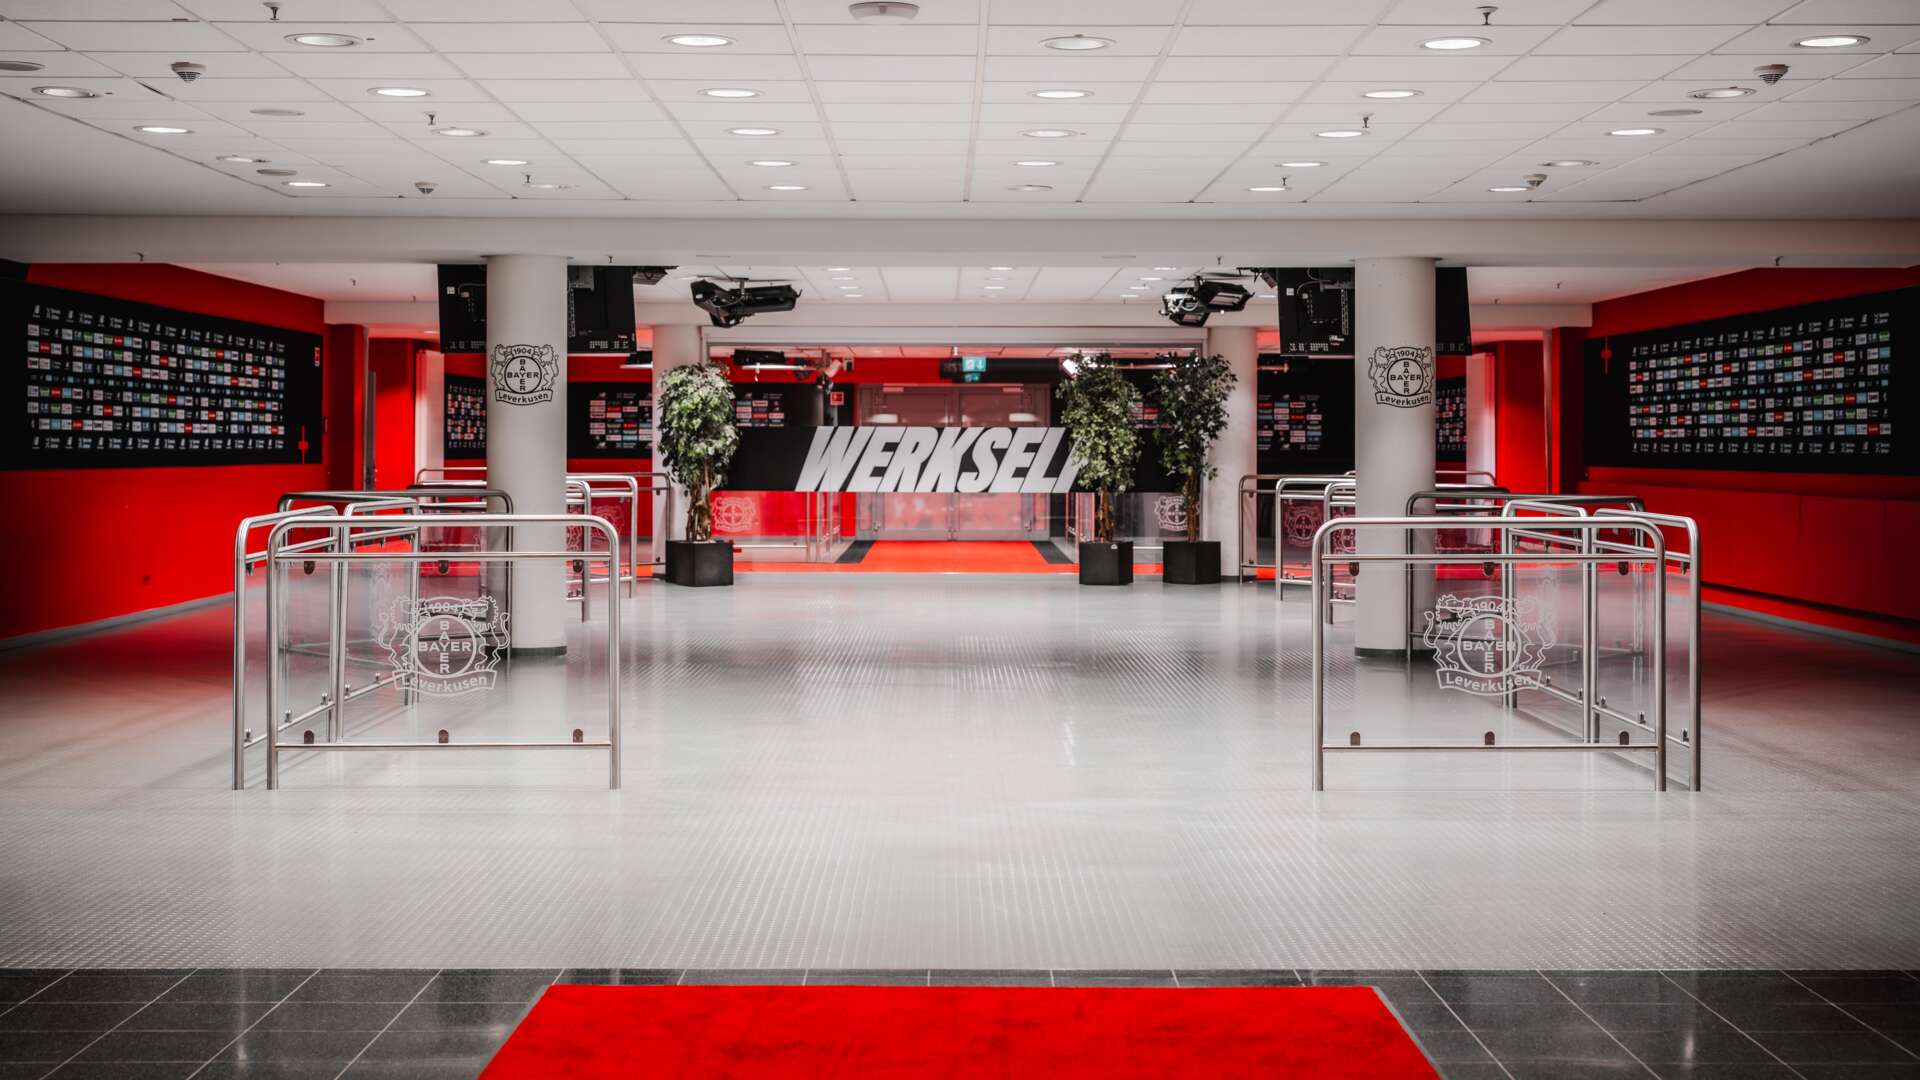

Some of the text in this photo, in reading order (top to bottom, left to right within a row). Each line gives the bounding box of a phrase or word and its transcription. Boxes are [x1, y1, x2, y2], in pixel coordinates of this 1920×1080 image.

[513, 347, 532, 355] 1904
[498, 392, 549, 402] Leverkusen
[1380, 395, 1429, 405] Leverkusen
[419, 641, 472, 652] BAYER
[1463, 641, 1516, 651] BAYER
[401, 675, 488, 693] Leverkusen
[1445, 672, 1533, 692] Leverkusen
